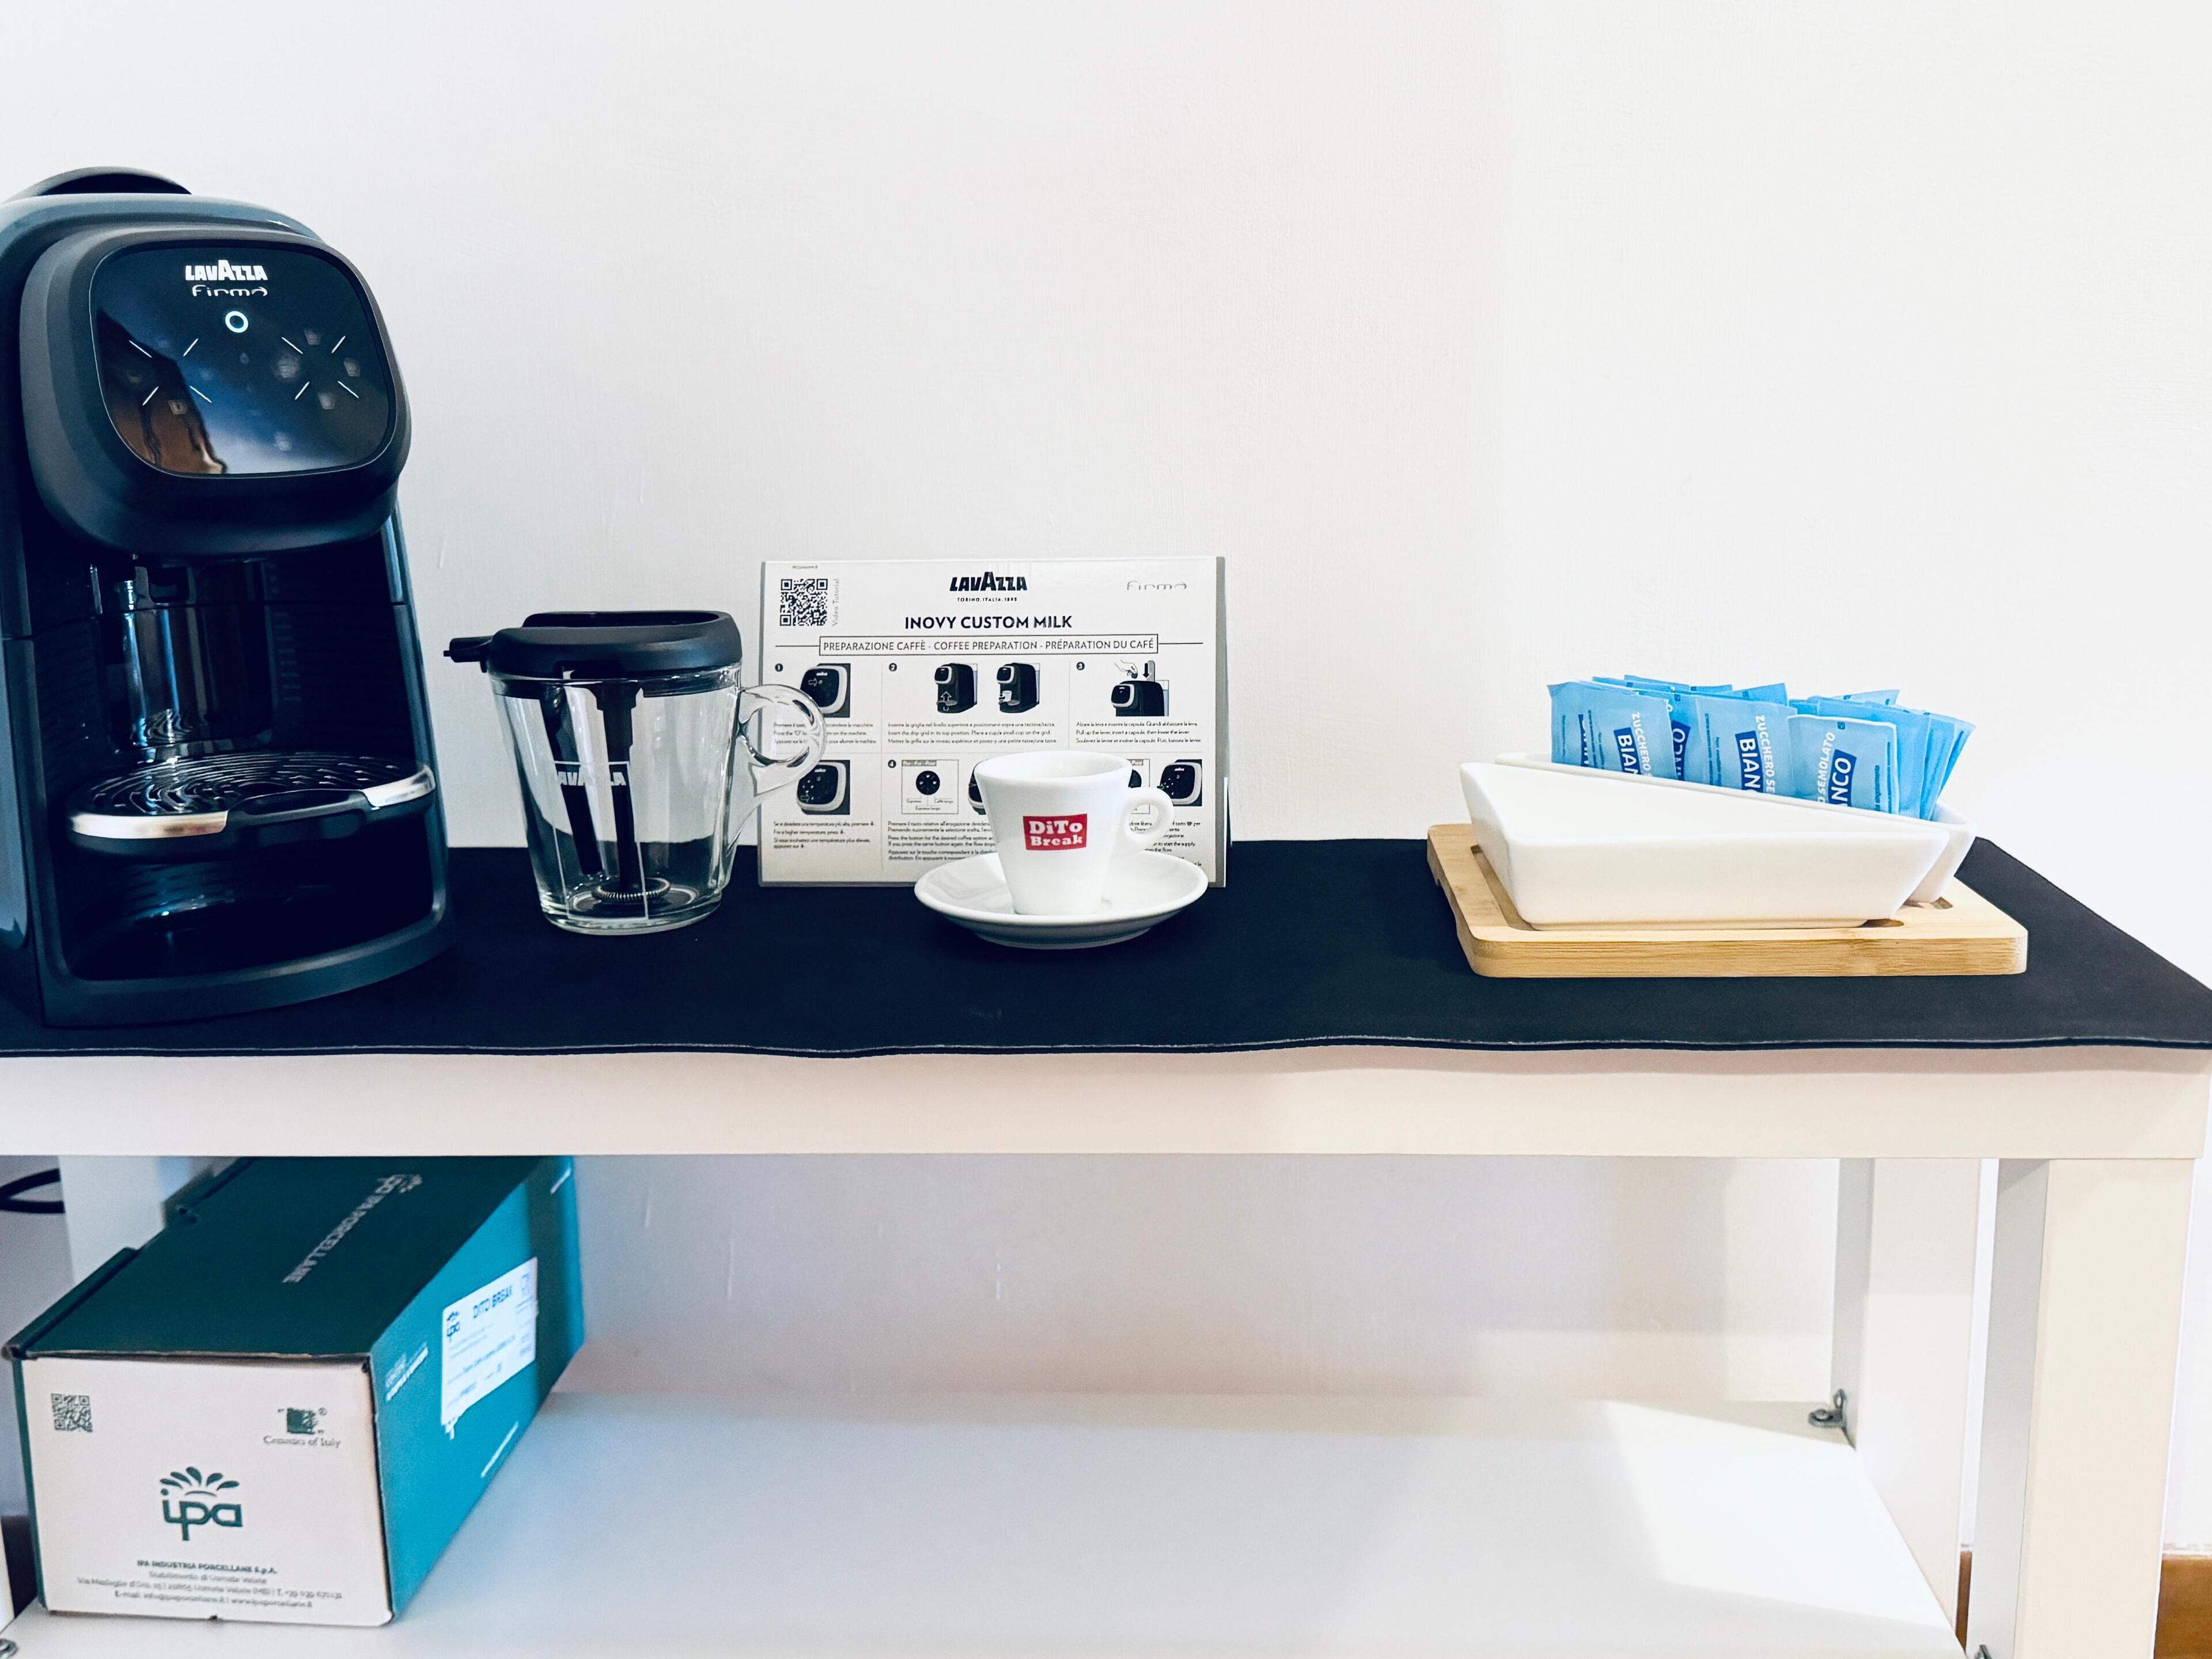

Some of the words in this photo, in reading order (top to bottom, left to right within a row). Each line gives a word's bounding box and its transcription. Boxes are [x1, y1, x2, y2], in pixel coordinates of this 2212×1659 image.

[185, 260, 268, 281] LAVAZZA
[949, 571, 1028, 592] LAVAZZA
[906, 617, 956, 629] INOVY
[960, 616, 1029, 629] CUSTOM
[1033, 616, 1073, 628] MILK
[823, 642, 894, 651] PREPARAZIONE
[896, 639, 926, 650] CAFFÈ
[934, 641, 969, 650] COFFEE
[972, 641, 1037, 650] PREPARATION
[1045, 639, 1111, 650] PRÉPARATION
[1113, 641, 1127, 649] DU
[1130, 638, 1154, 649] CAFÉ
[1631, 711, 1652, 771] ZUCCHERO
[1755, 714, 1775, 778] ZUCCHERO
[1739, 738, 1761, 793] BIAN
[1817, 731, 1836, 795] SEMOLATO
[1028, 820, 1084, 835] DiTo
[1030, 835, 1083, 847] Break
[161, 1488, 243, 1541] ipa
